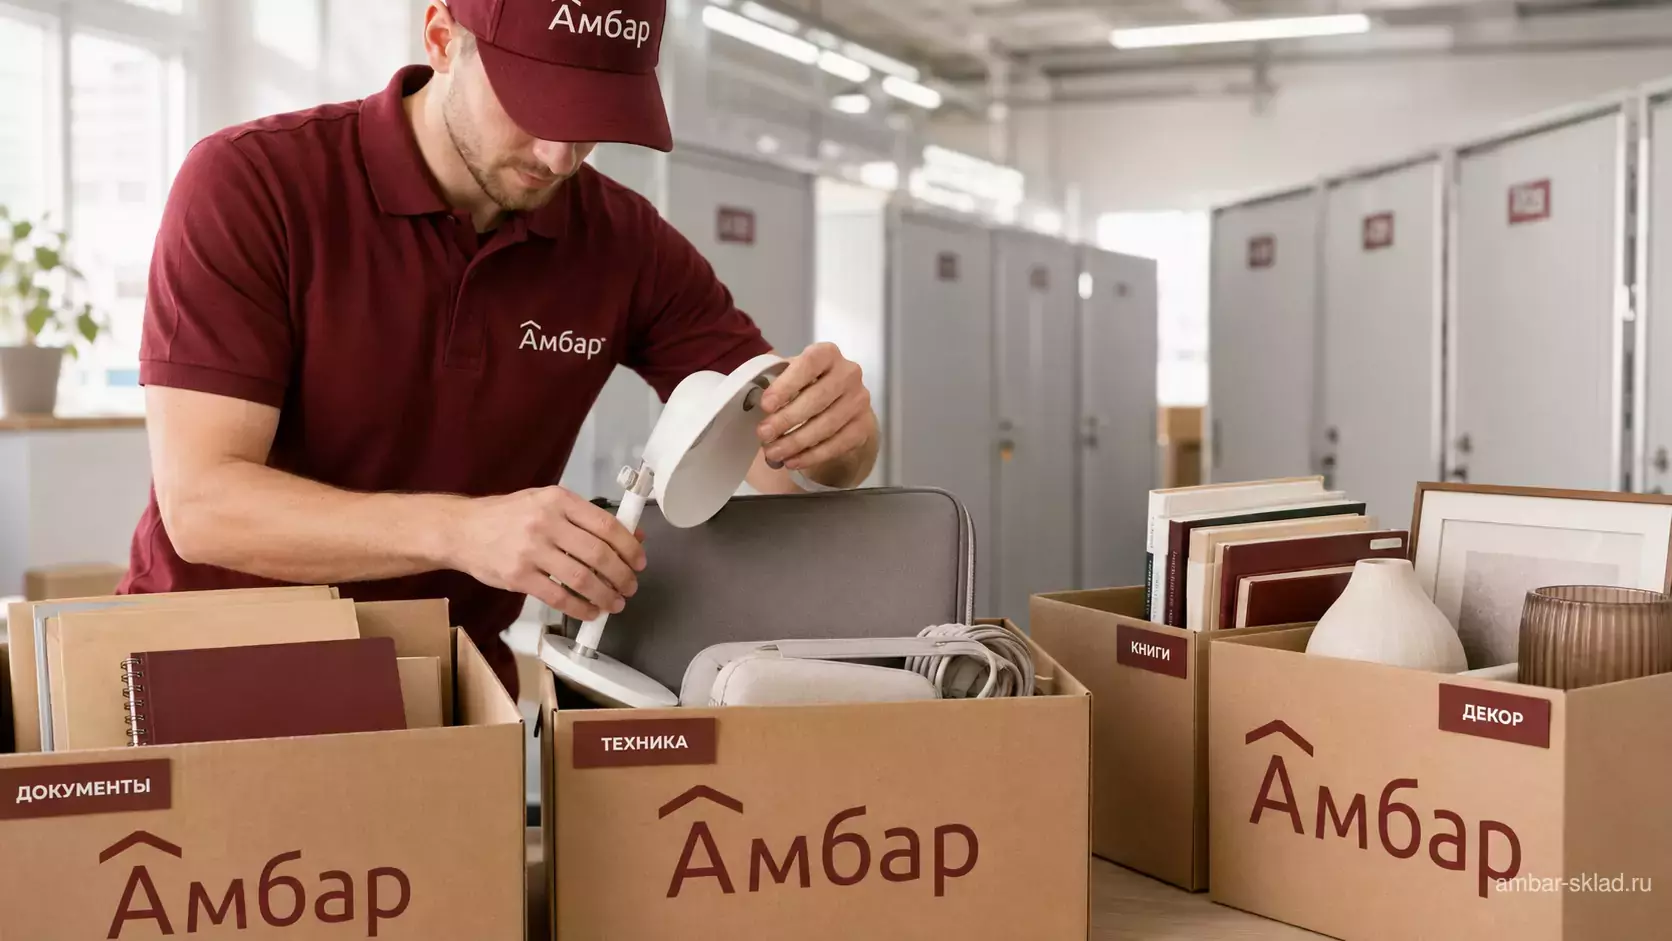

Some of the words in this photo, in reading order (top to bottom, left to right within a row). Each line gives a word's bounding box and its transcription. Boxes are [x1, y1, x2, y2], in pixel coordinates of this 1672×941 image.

[1131, 641, 1171, 662] КНИГИ
[1462, 703, 1524, 727] ДЕКОР
[600, 734, 689, 752] ТЕХНИКА
[16, 778, 152, 804] ДОКУМЕНТЫ
